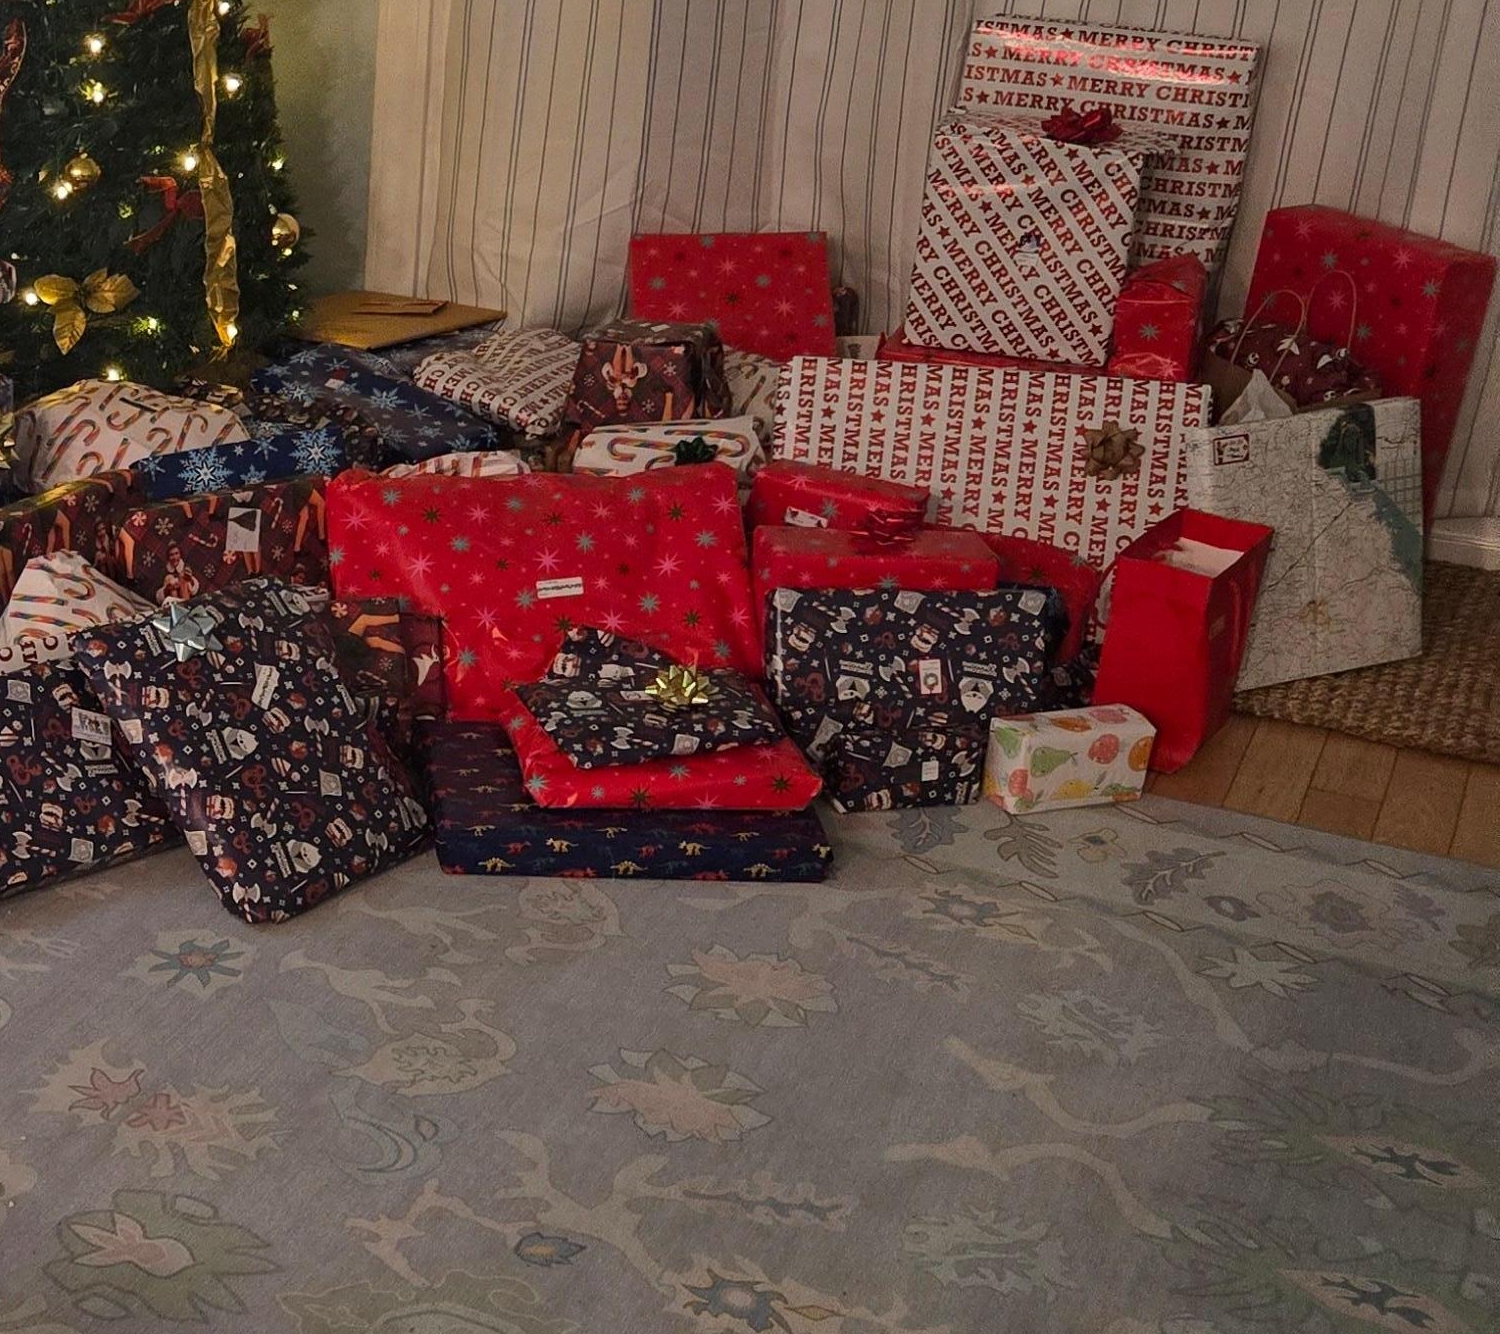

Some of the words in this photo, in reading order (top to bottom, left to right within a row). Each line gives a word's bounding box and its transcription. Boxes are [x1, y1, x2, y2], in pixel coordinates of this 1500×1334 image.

[992, 91, 1074, 112] MERRY
[1066, 75, 1150, 98] MERRY
[969, 144, 1024, 212] MERRY
[1071, 160, 1128, 229] MERRY
[1027, 186, 1083, 255] MERRY
[928, 168, 981, 238] MERRY
[974, 240, 1055, 348] CHRISTMAS
[942, 238, 998, 307] MERRY
[962, 435, 988, 518] MERRY
[1013, 439, 1038, 522] MERRY
